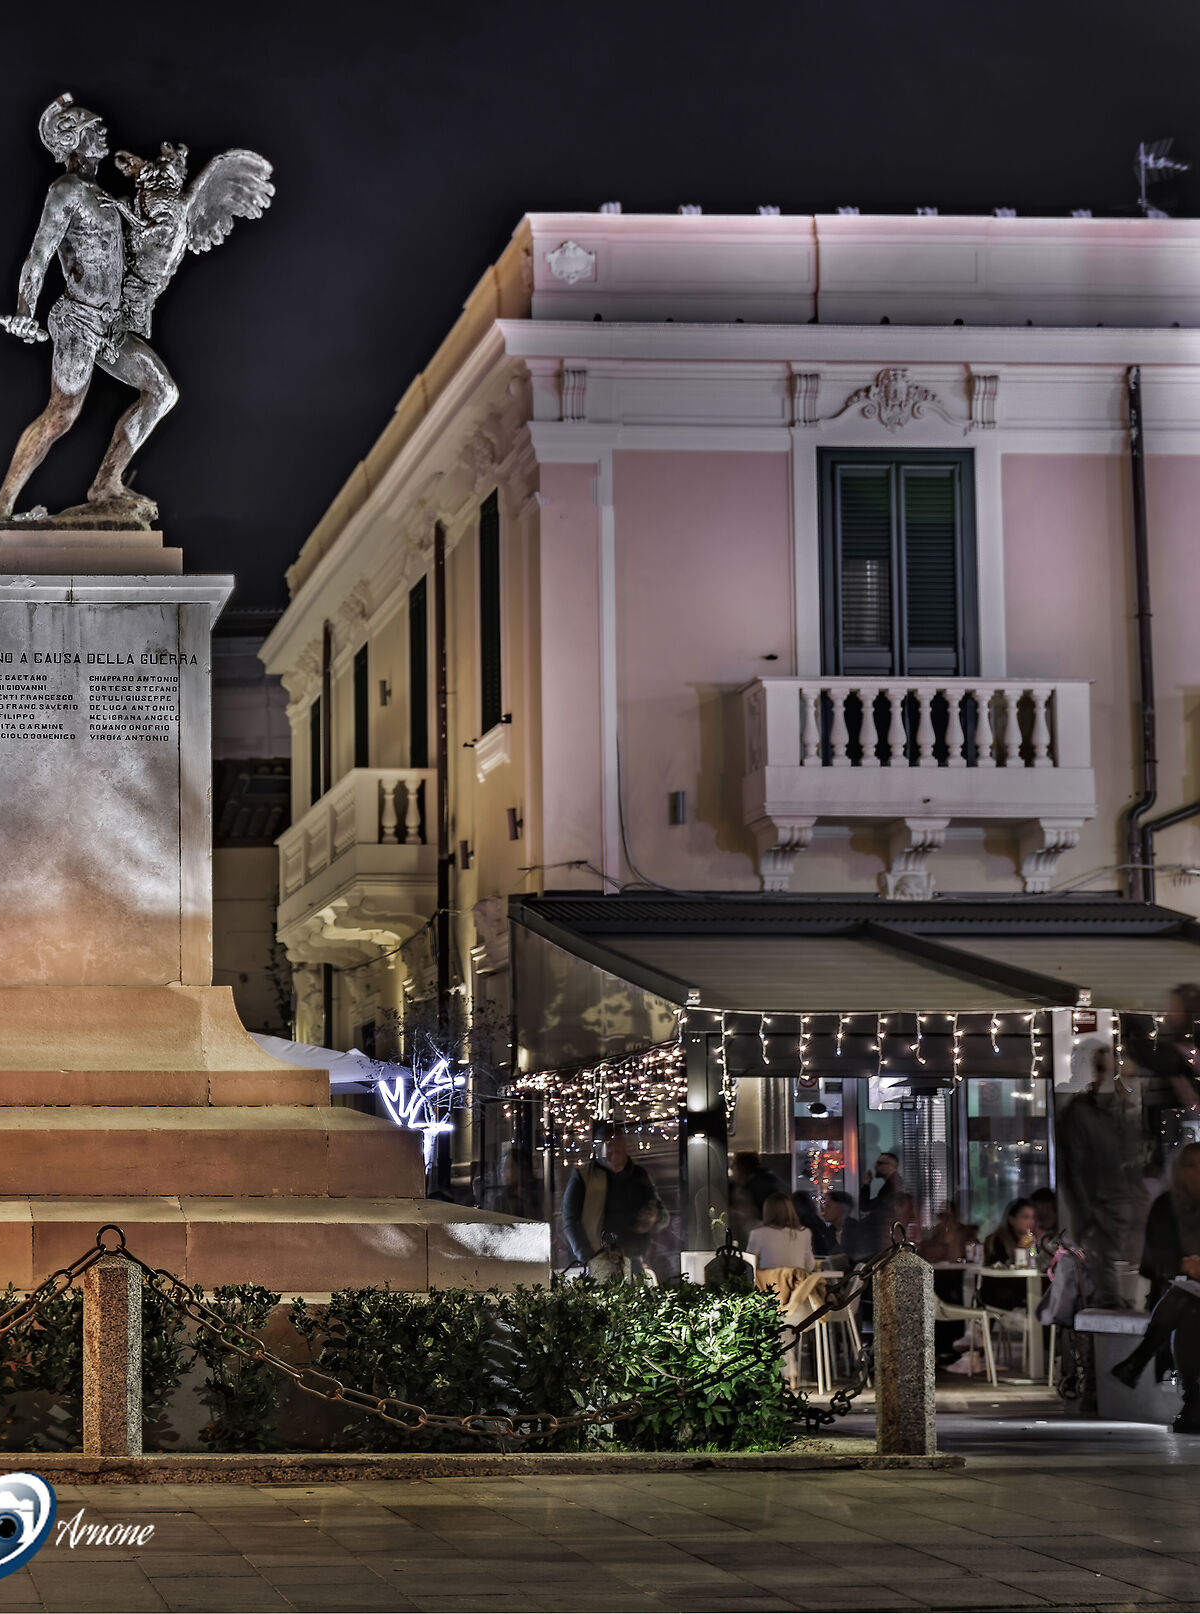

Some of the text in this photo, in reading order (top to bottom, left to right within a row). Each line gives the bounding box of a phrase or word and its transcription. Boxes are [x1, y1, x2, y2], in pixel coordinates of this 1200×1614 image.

[19, 652, 29, 664] A
[34, 652, 81, 664] CAUSA
[87, 653, 135, 665] DELLA
[140, 653, 198, 666] GUERRA
[136, 675, 179, 683] ANTONIO
[6, 683, 47, 692] GIOVANNI
[89, 685, 178, 693] CORTESE STEFANO
[20, 693, 74, 701] FRANCESCO
[39, 702, 79, 711] SAVERIO
[131, 704, 175, 712] ANTONIO
[144, 714, 180, 722] ANGELO
[89, 723, 170, 731] ROMANO ONOFRIO
[124, 734, 169, 742] ANTONIO
